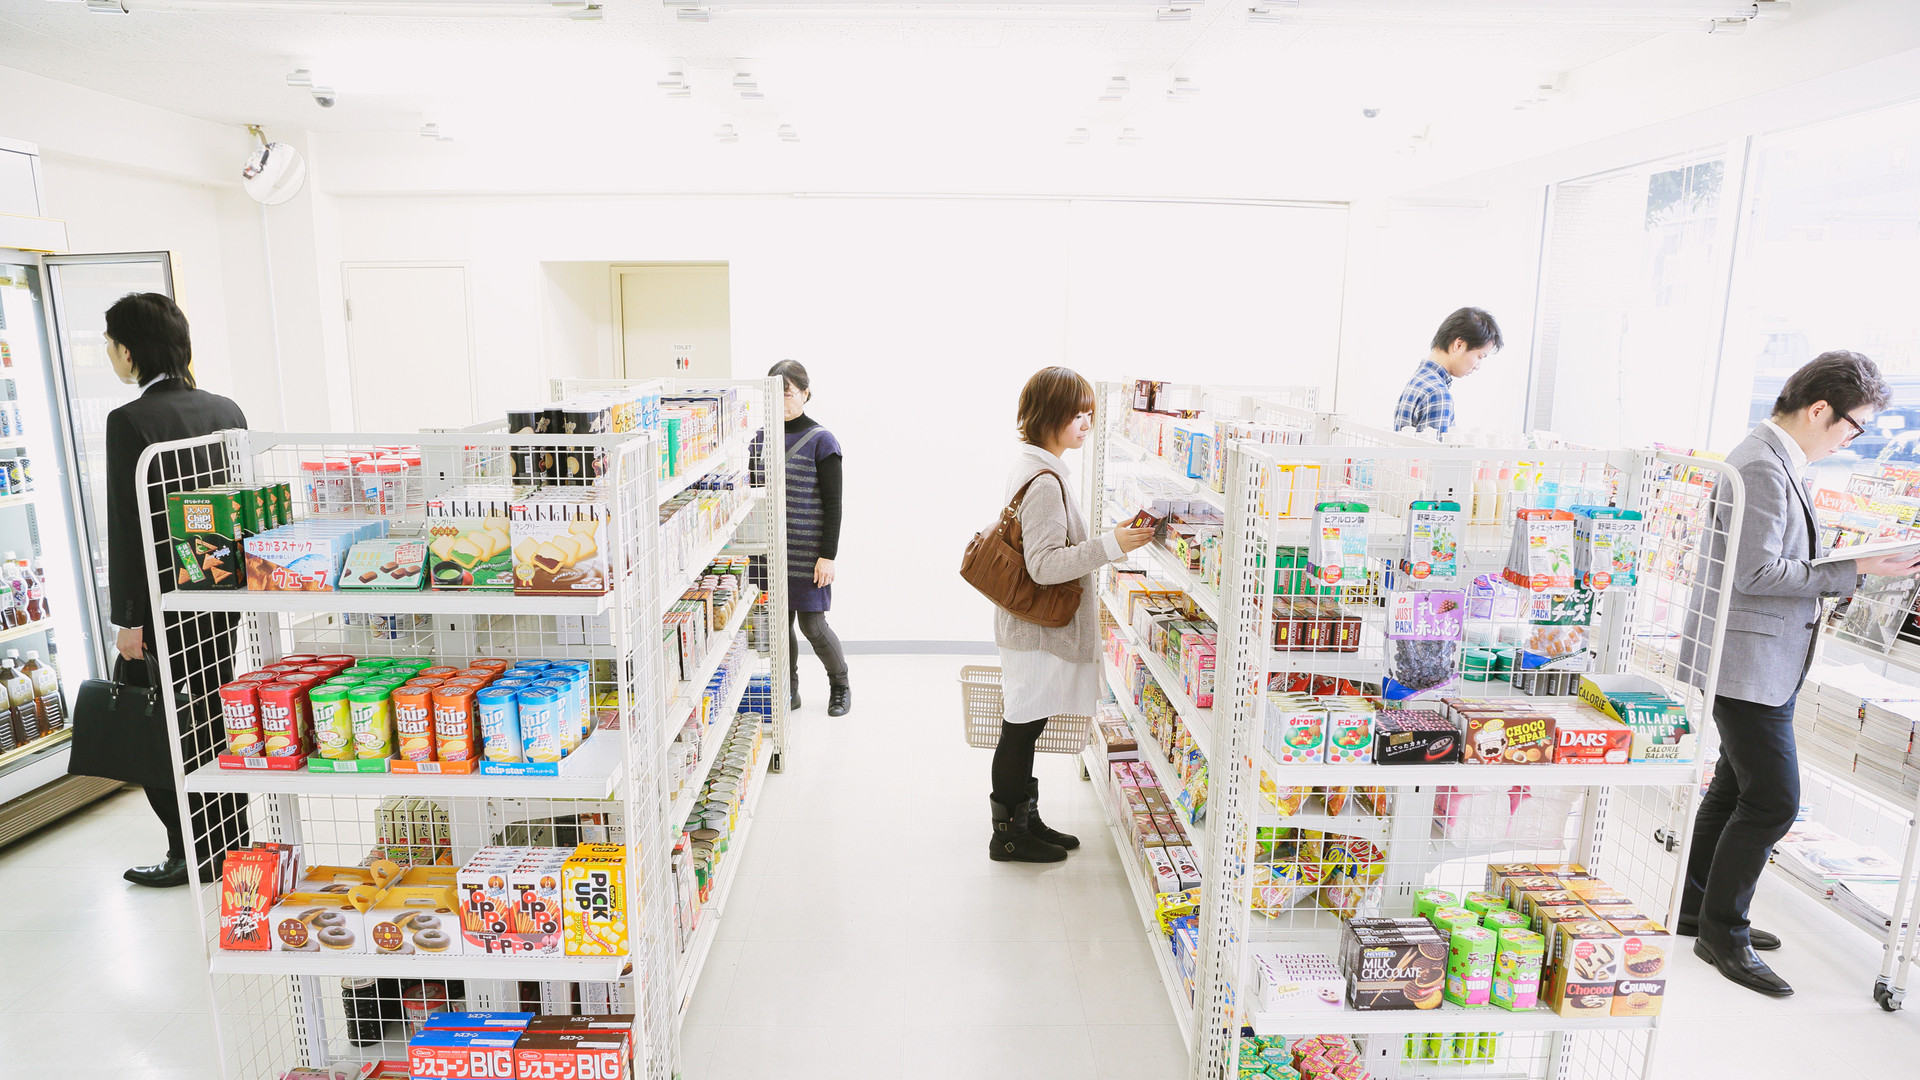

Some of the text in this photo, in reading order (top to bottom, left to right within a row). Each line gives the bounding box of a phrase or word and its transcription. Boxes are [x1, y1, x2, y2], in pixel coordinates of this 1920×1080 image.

[187, 506, 210, 514] 大人の
[1324, 516, 1365, 524] ヒアルロン酸
[1417, 514, 1455, 522] 野菜ミックス
[187, 522, 213, 531] Chop
[1530, 524, 1571, 532] ダイエットサプリ
[1598, 522, 1636, 531] 野菜ミックス
[249, 540, 312, 552] かるかるスナック
[273, 568, 329, 589] ウェーブ
[1416, 601, 1436, 616] 干し
[1532, 600, 1550, 610] JUST
[1552, 602, 1590, 622] チーズ
[1395, 608, 1412, 620] JUST
[1531, 609, 1550, 619] PACK
[1395, 620, 1413, 633] PACK
[1415, 617, 1461, 637] 赤ぶどう
[1578, 686, 1607, 711] CALORIE
[396, 707, 428, 721] chip
[434, 710, 467, 724] chip
[1628, 710, 1686, 726] BALANCE
[397, 720, 429, 733] star
[1289, 717, 1322, 726] drops
[435, 722, 468, 736] star
[1506, 720, 1546, 738] CHOCO
[1630, 724, 1676, 737] POWER
[1386, 738, 1427, 753] ほてったカカオ
[1560, 731, 1608, 747] DARS
[485, 766, 504, 774] chip
[505, 767, 526, 775] star
[224, 887, 268, 912] POCKY
[575, 882, 591, 910] UP
[591, 873, 609, 920] PICK
[462, 883, 507, 934] Toppo
[513, 884, 557, 934] Toppo
[234, 920, 259, 938] チョコ
[282, 922, 302, 930] チョコ
[376, 925, 397, 933] チョコ
[479, 934, 534, 954] Toppo
[1362, 958, 1390, 969] MILK
[1361, 966, 1422, 979] CHOCOLATE
[1566, 984, 1614, 996] Chococo
[1619, 980, 1662, 994] CRUNKY
[412, 1051, 512, 1078] シスコーン BIG
[519, 1054, 619, 1080] シスコーン BIG
